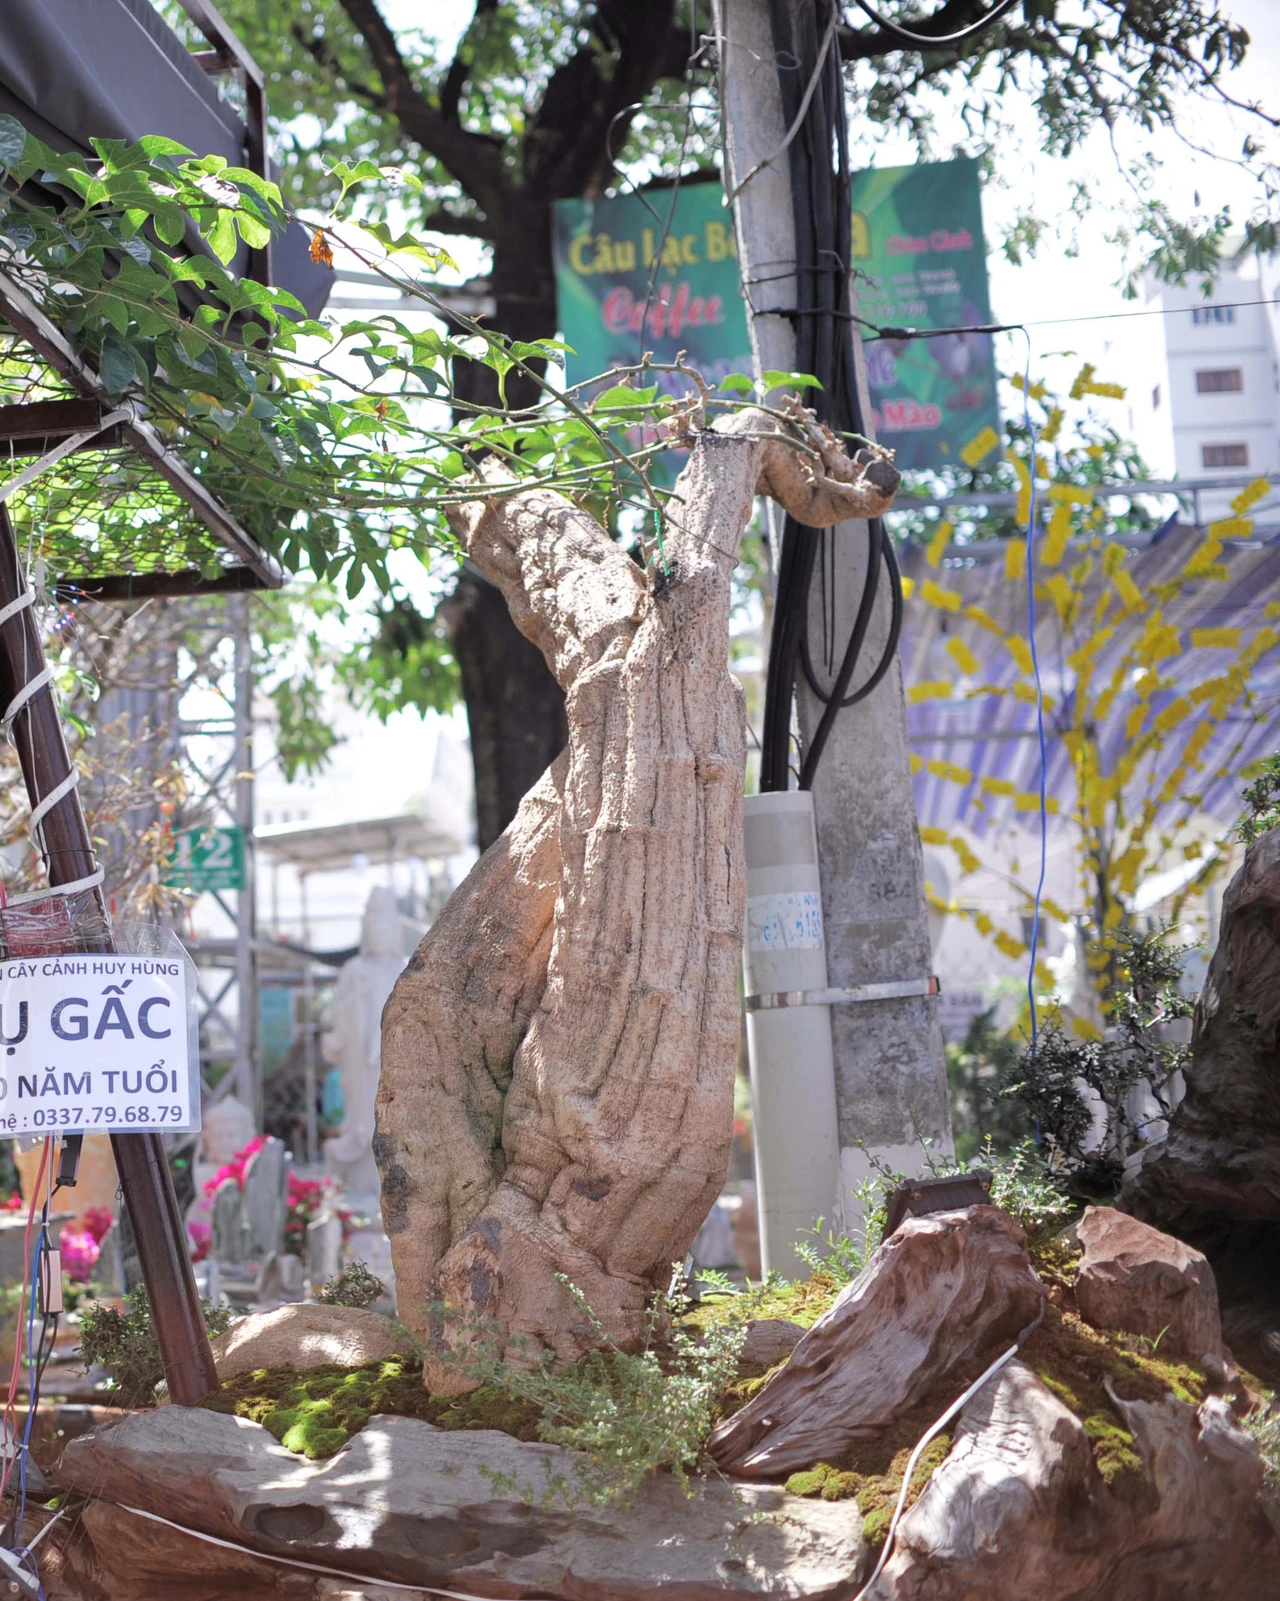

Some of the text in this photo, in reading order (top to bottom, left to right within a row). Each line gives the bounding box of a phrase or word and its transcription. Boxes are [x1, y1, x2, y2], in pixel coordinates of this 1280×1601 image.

[570, 232, 636, 275] Câu
[175, 829, 233, 869] 12
[8, 961, 38, 979] CÂY
[42, 958, 87, 977] CẢNH
[93, 962, 126, 976] HUY
[131, 959, 179, 977] HÙNG
[50, 979, 172, 1041] GẤC
[17, 1066, 93, 1099] NĂM
[101, 1059, 178, 1095] TUỔI
[33, 1105, 183, 1127] 0337.79.68.79
